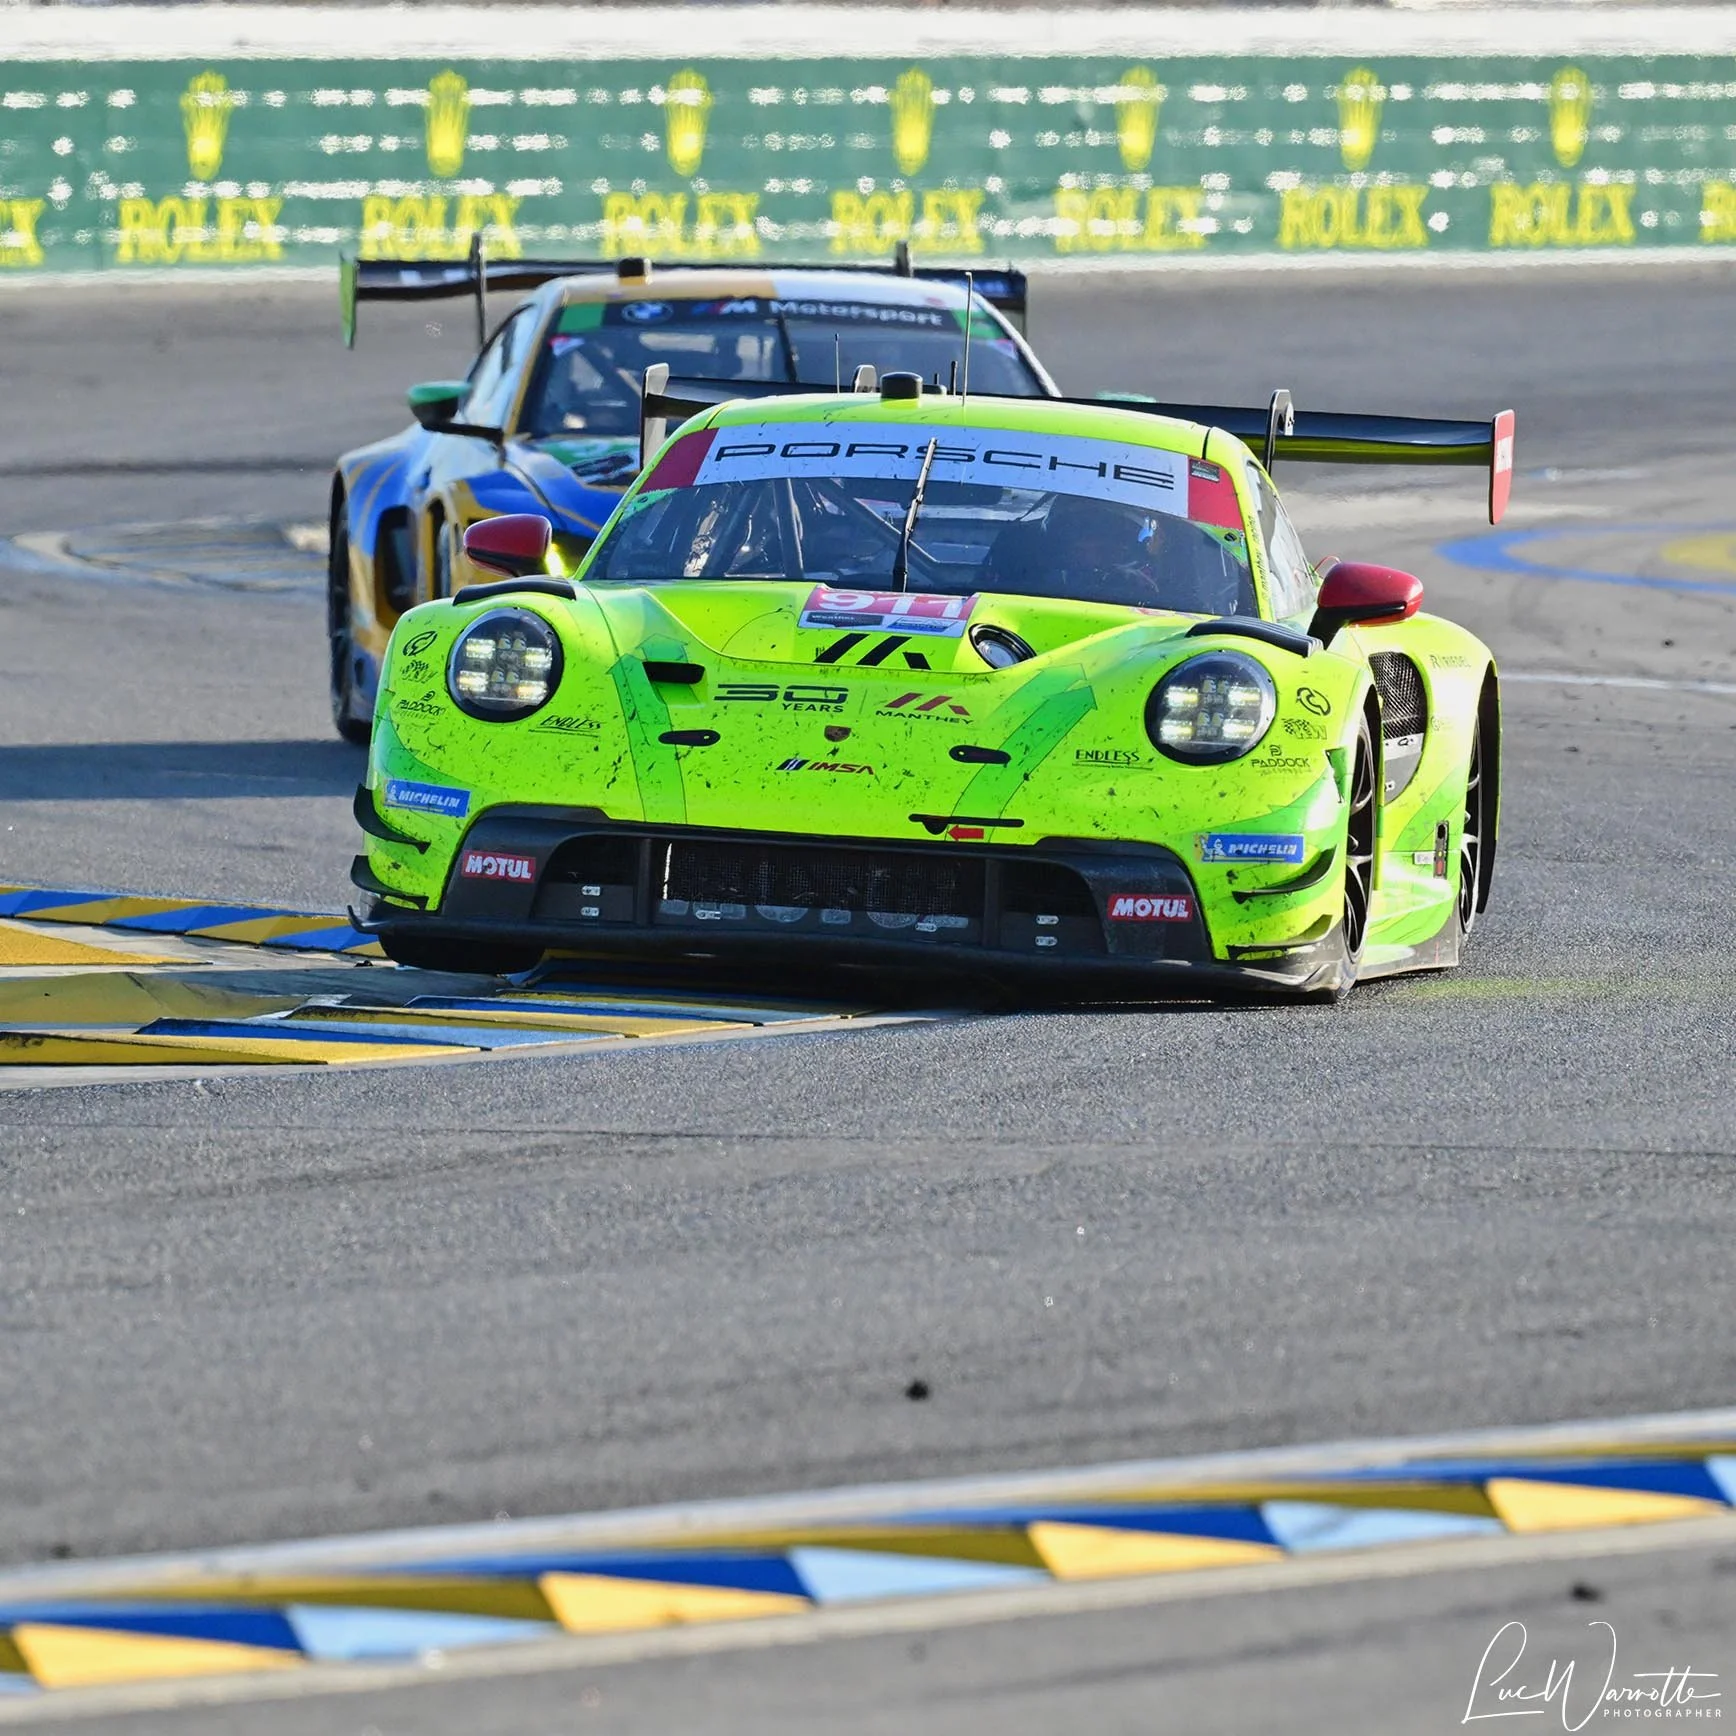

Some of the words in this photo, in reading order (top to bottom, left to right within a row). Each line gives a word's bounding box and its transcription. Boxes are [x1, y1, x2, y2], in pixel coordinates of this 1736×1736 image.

[602, 192, 759, 259] ROLEX
[831, 190, 983, 253] ROLEX
[1055, 186, 1206, 250] ROLEX
[1278, 185, 1427, 247] ROLEX
[1490, 182, 1636, 245] ROLEX
[117, 196, 283, 262] ROLEX
[361, 194, 520, 262] ROLEX
[769, 300, 943, 326] Motorsport
[714, 441, 1175, 492] PORSCHE
[818, 591, 967, 619] 911
[713, 683, 849, 704] 30
[781, 703, 844, 713] YEARS
[875, 710, 974, 725] MANTHEY
[807, 761, 874, 776] IMSA
[1074, 749, 1140, 762] ENDLESS
[1251, 757, 1310, 769] PADDOCK
[397, 790, 461, 809] MICHELIN
[1227, 843, 1298, 856] MICHELIN
[464, 854, 532, 880] MOTUL
[1111, 897, 1189, 919] MOTUL
